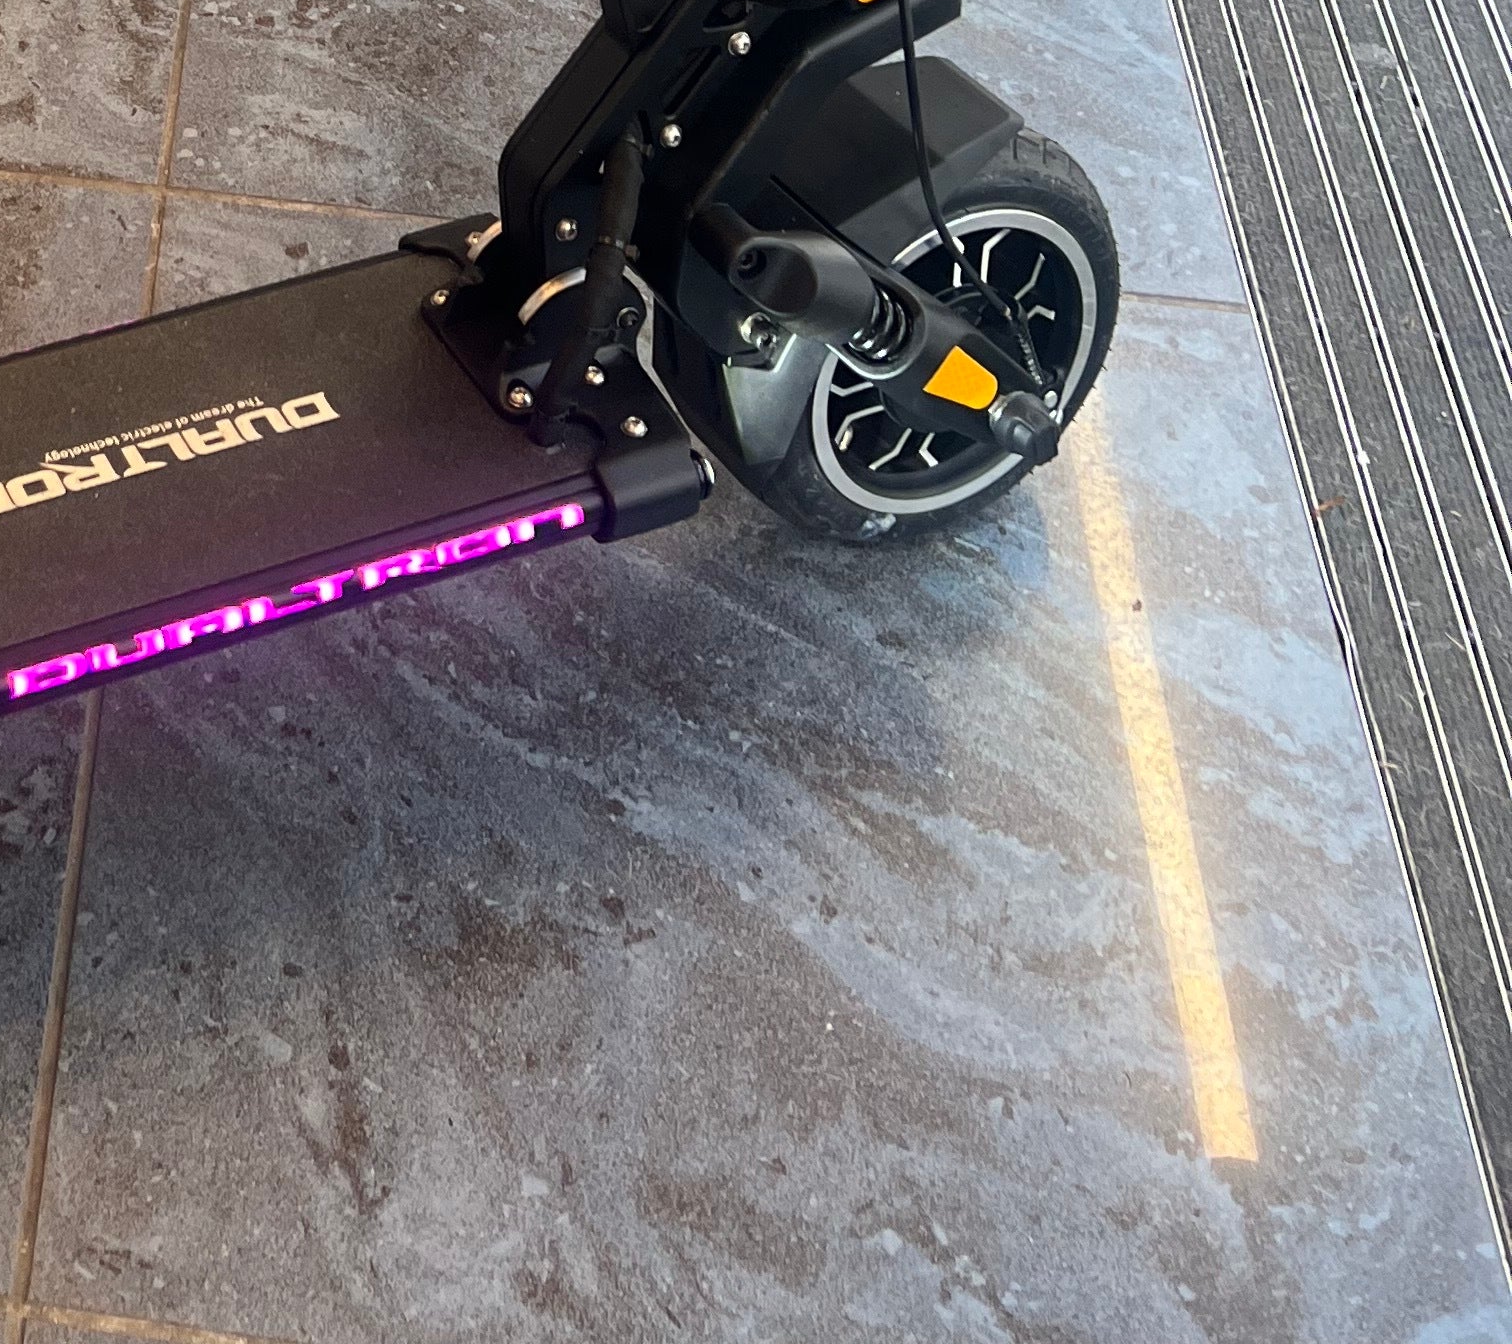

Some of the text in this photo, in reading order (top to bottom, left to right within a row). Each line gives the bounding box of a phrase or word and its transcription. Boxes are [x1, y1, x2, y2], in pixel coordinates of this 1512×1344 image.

[44, 396, 264, 463] The dream of electric technology
[9, 503, 584, 701] DUALTRON
